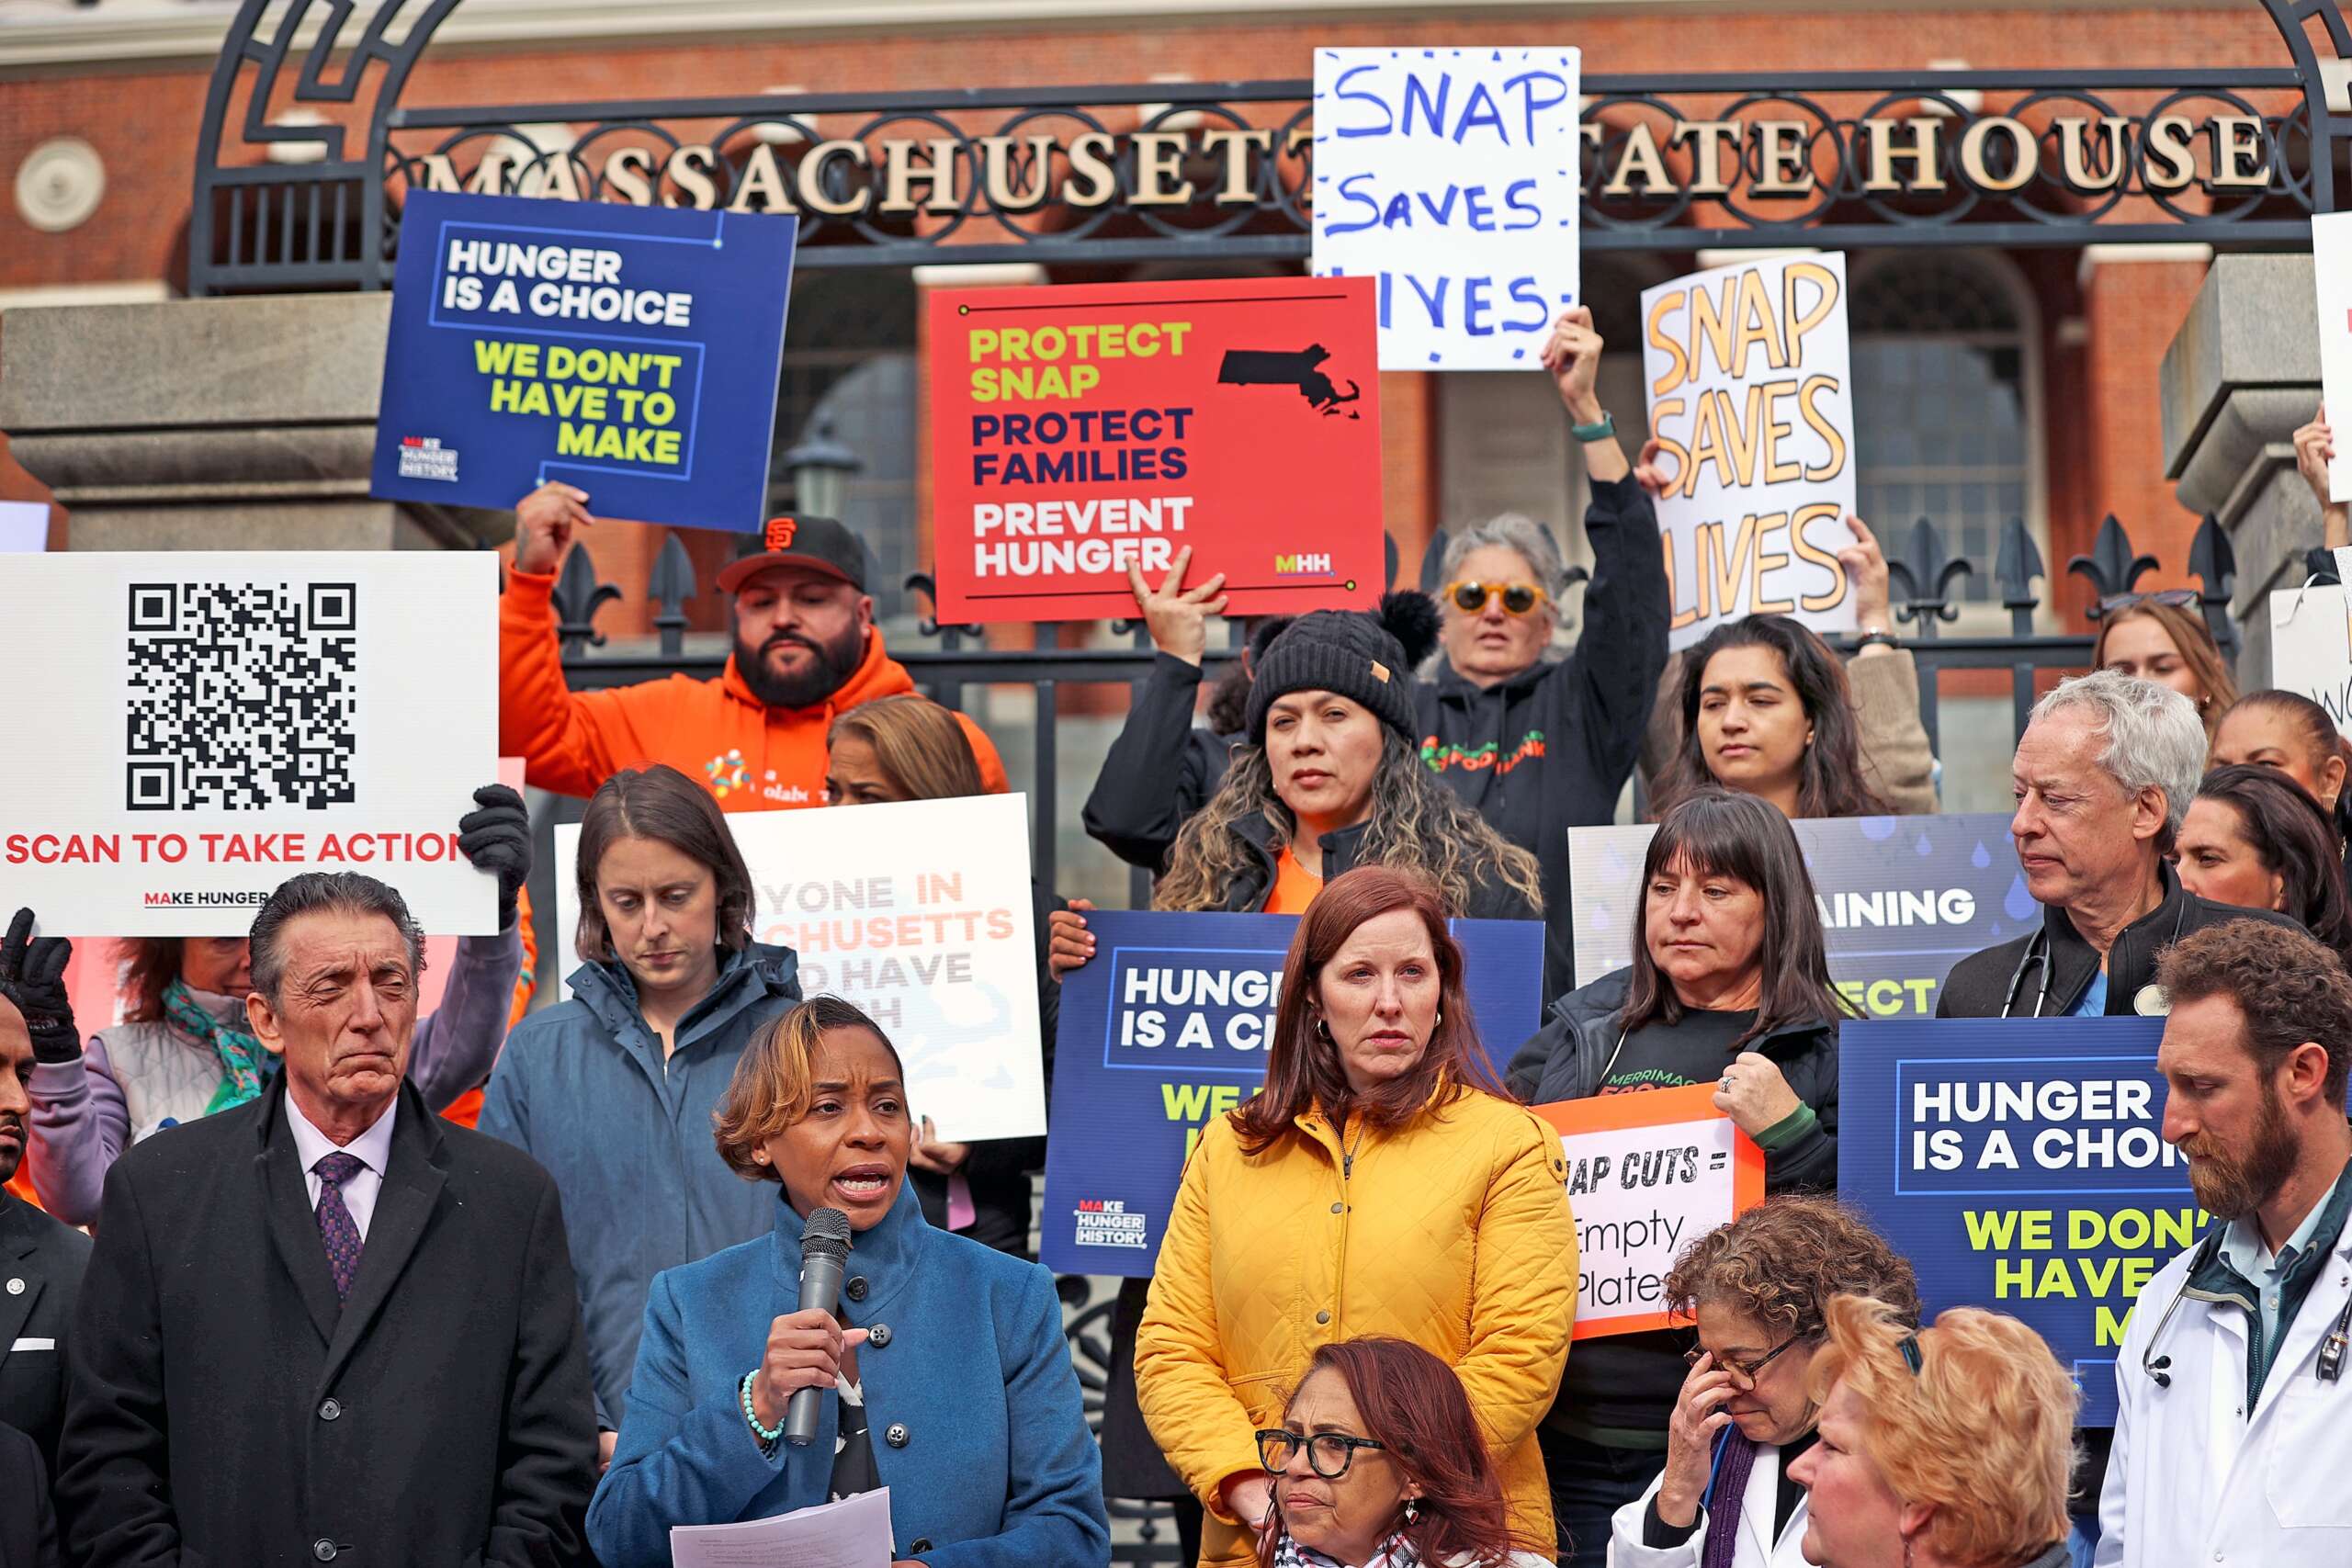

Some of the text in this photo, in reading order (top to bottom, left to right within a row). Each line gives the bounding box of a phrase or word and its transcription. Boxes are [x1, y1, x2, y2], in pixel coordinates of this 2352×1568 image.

[1334, 65, 1567, 147] SNAP
[422, 115, 2271, 214] MASSACHUSET ATE HOUSE
[1324, 173, 1542, 237] SAVES
[447, 240, 623, 284] HUNGER
[443, 276, 693, 327] IS A CHOICE
[1331, 267, 1548, 337] IVES
[969, 322, 1192, 363] PROTECT
[1648, 262, 1839, 397] SNAP
[474, 340, 682, 389] WE DON'T
[969, 365, 1101, 401] SNAP
[490, 378, 676, 426] HAVE TO
[557, 422, 682, 465] MAKE
[972, 408, 1193, 446] PROTECT
[1651, 374, 1846, 500] SAVES
[973, 447, 1188, 486] FAMILIES
[973, 497, 1193, 537] PREVENT
[975, 538, 1173, 577] HUNGER
[1276, 553, 1330, 573] MHH
[6, 833, 120, 864] SCAN
[132, 833, 188, 864] TO
[199, 833, 305, 863] TAKE
[144, 892, 194, 905] MAKE
[917, 872, 963, 905] IN
[842, 952, 973, 991] HAVE
[1125, 968, 1283, 1008] HUNG
[1121, 1010, 1167, 1048] IS
[1176, 1012, 1215, 1049] A
[1161, 1084, 1240, 1122] WE
[1914, 1079, 2153, 1122] HUNGER
[1621, 1145, 1700, 1190] CUTS
[1914, 1129, 1963, 1170] IS
[1976, 1129, 2019, 1169] A
[1078, 1214, 1142, 1229] HUNGER
[1080, 1200, 1124, 1213] MAKE
[1080, 1229, 1147, 1244] HISTORY
[1962, 1208, 2218, 1250] WE DON'
[1995, 1258, 2154, 1299] HAVE
